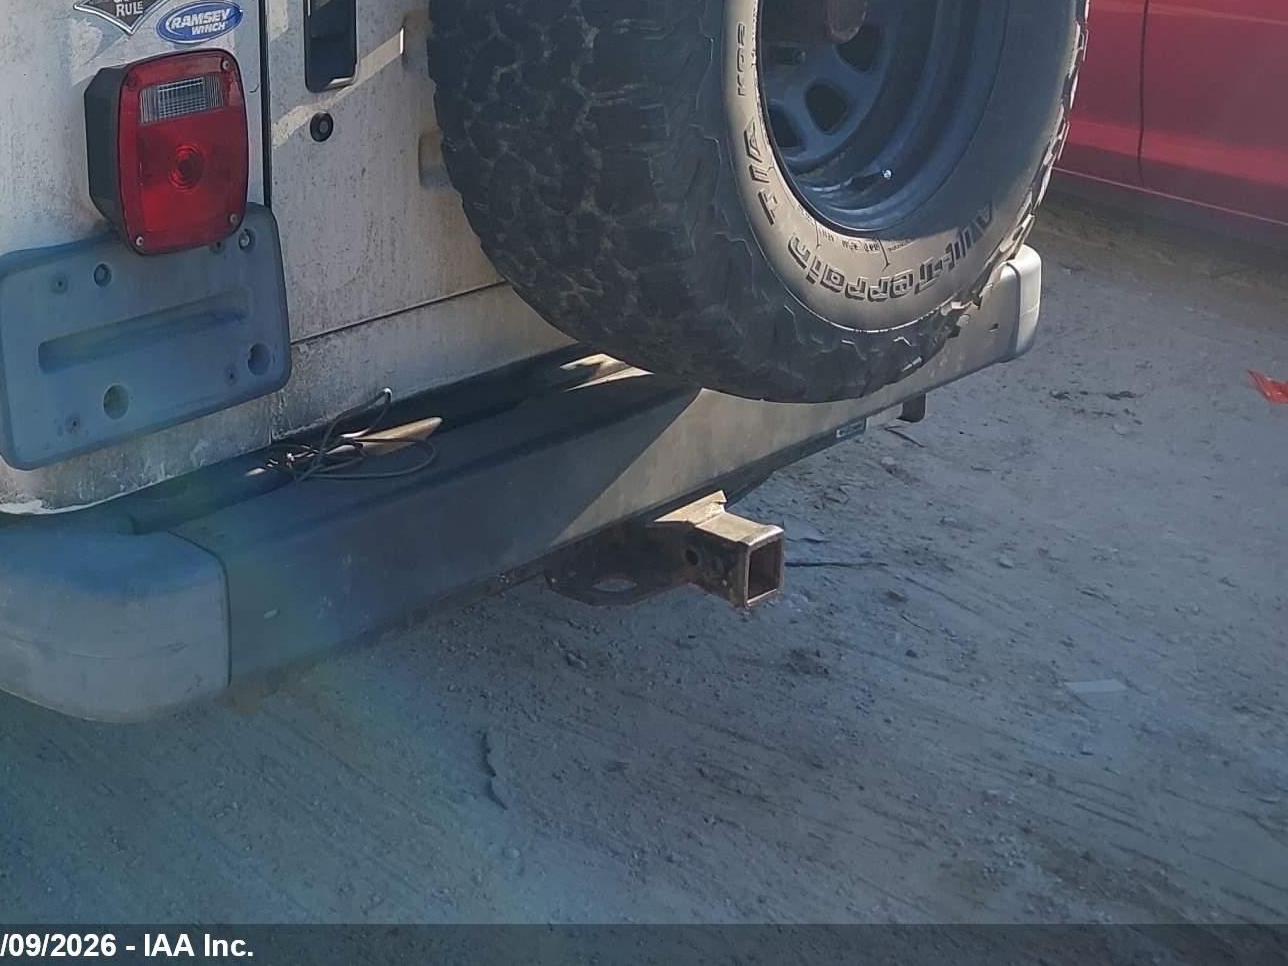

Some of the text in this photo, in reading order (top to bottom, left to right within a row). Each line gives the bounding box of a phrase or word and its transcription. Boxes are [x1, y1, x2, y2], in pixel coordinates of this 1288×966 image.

[116, 1, 143, 17] RULE
[171, 8, 231, 29] RAMSEY
[191, 20, 228, 36] WINCH
